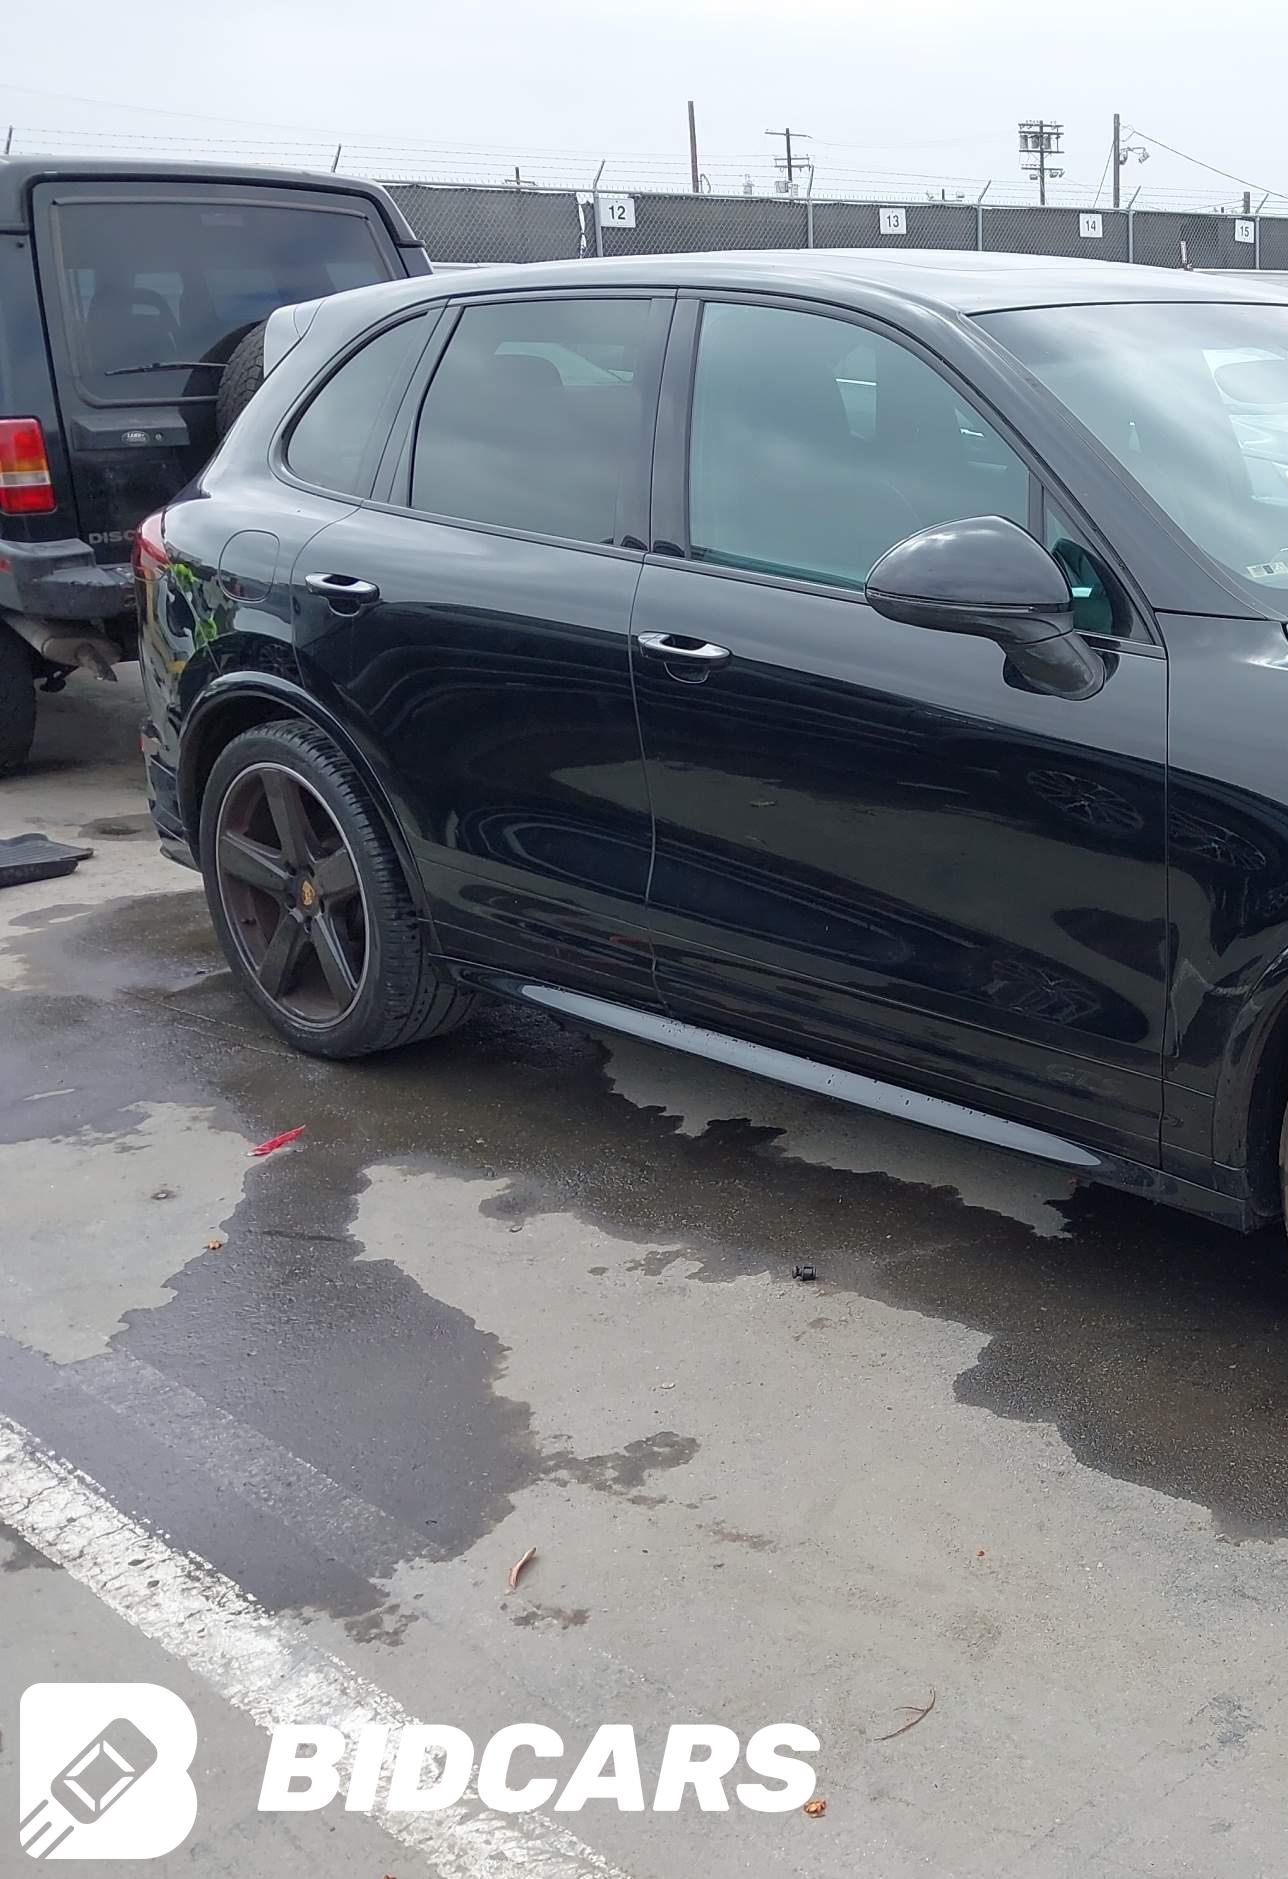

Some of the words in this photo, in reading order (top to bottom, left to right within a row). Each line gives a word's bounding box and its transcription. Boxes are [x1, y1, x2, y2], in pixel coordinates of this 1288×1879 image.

[608, 205, 626, 220] 12
[886, 214, 900, 228] 13
[1085, 220, 1096, 232] 14
[1240, 225, 1250, 237] 15
